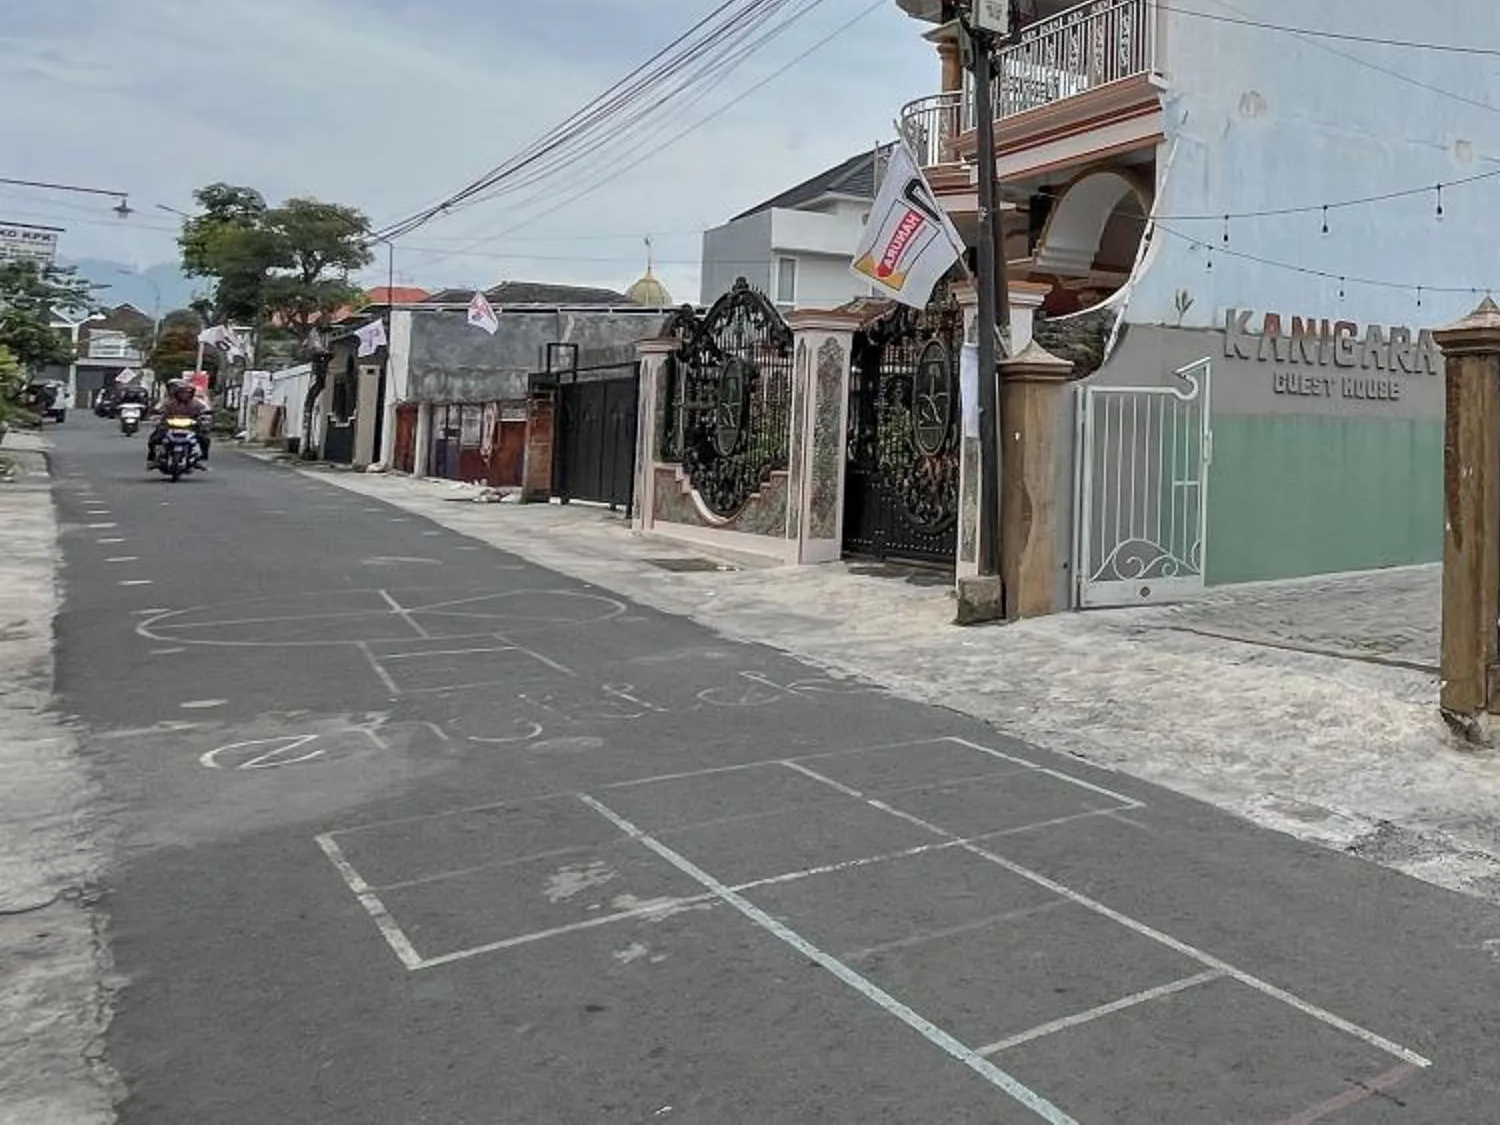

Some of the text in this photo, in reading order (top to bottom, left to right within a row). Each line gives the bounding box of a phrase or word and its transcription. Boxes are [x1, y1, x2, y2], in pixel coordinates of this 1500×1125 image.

[1223, 307, 1438, 376] KANIGARA
[1273, 371, 1401, 401] GUEST HOUSE
